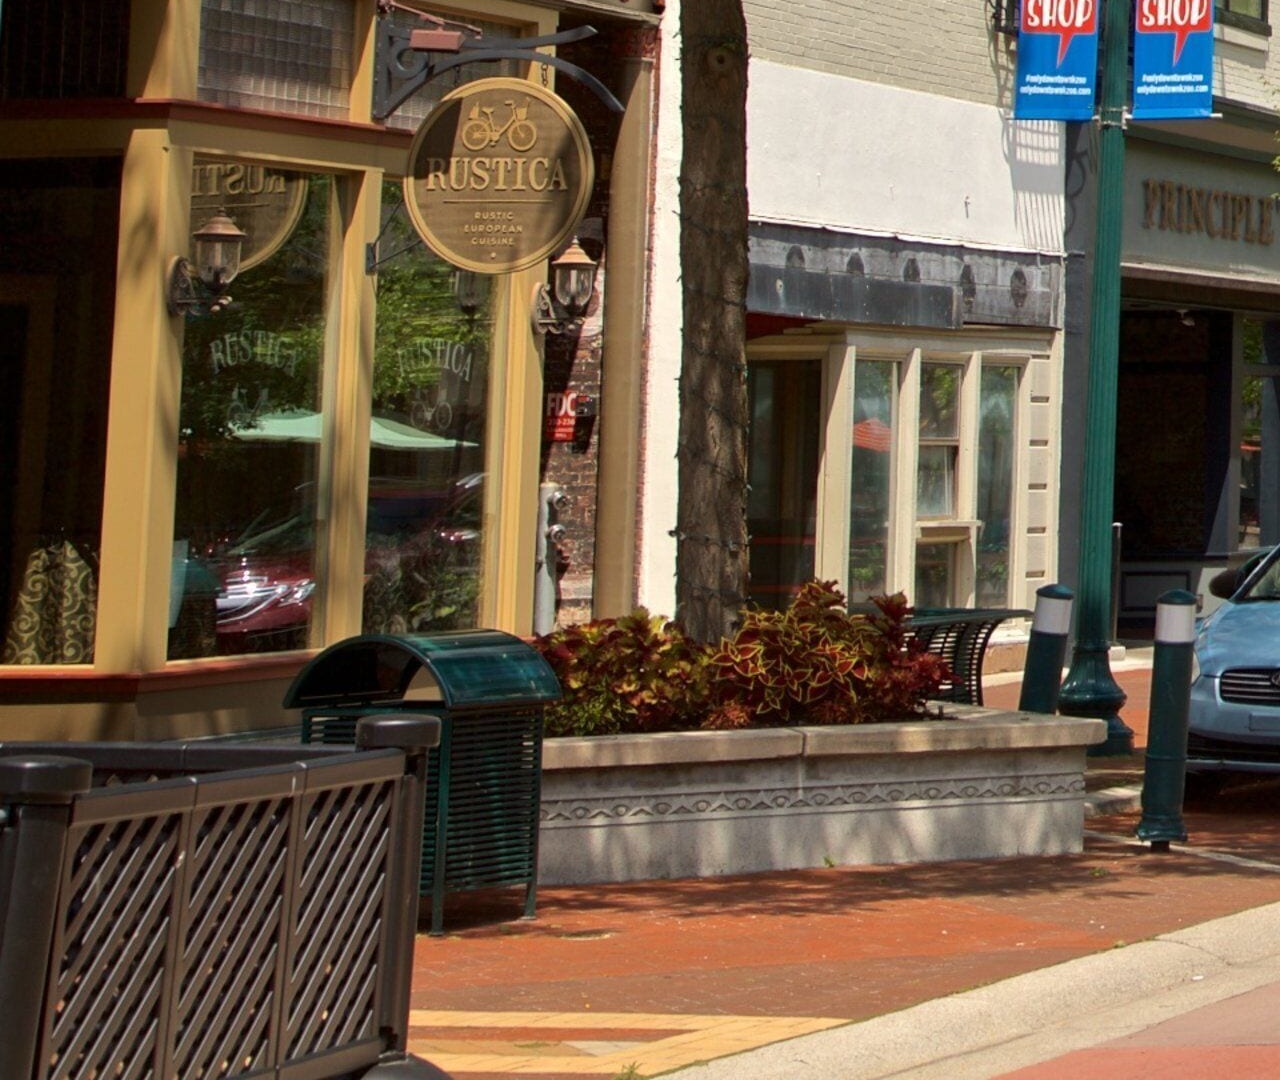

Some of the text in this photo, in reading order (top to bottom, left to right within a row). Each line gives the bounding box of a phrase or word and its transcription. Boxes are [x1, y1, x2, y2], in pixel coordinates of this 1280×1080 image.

[426, 157, 569, 192] RUSTICA
[464, 225, 523, 233] EUROPEAN
[474, 211, 515, 220] RUSTIC
[1142, 178, 1275, 246] PRINCIPLE
[471, 237, 516, 246] CUISINE
[209, 329, 300, 377] RUSTICA
[398, 339, 473, 382] RUSTICA
